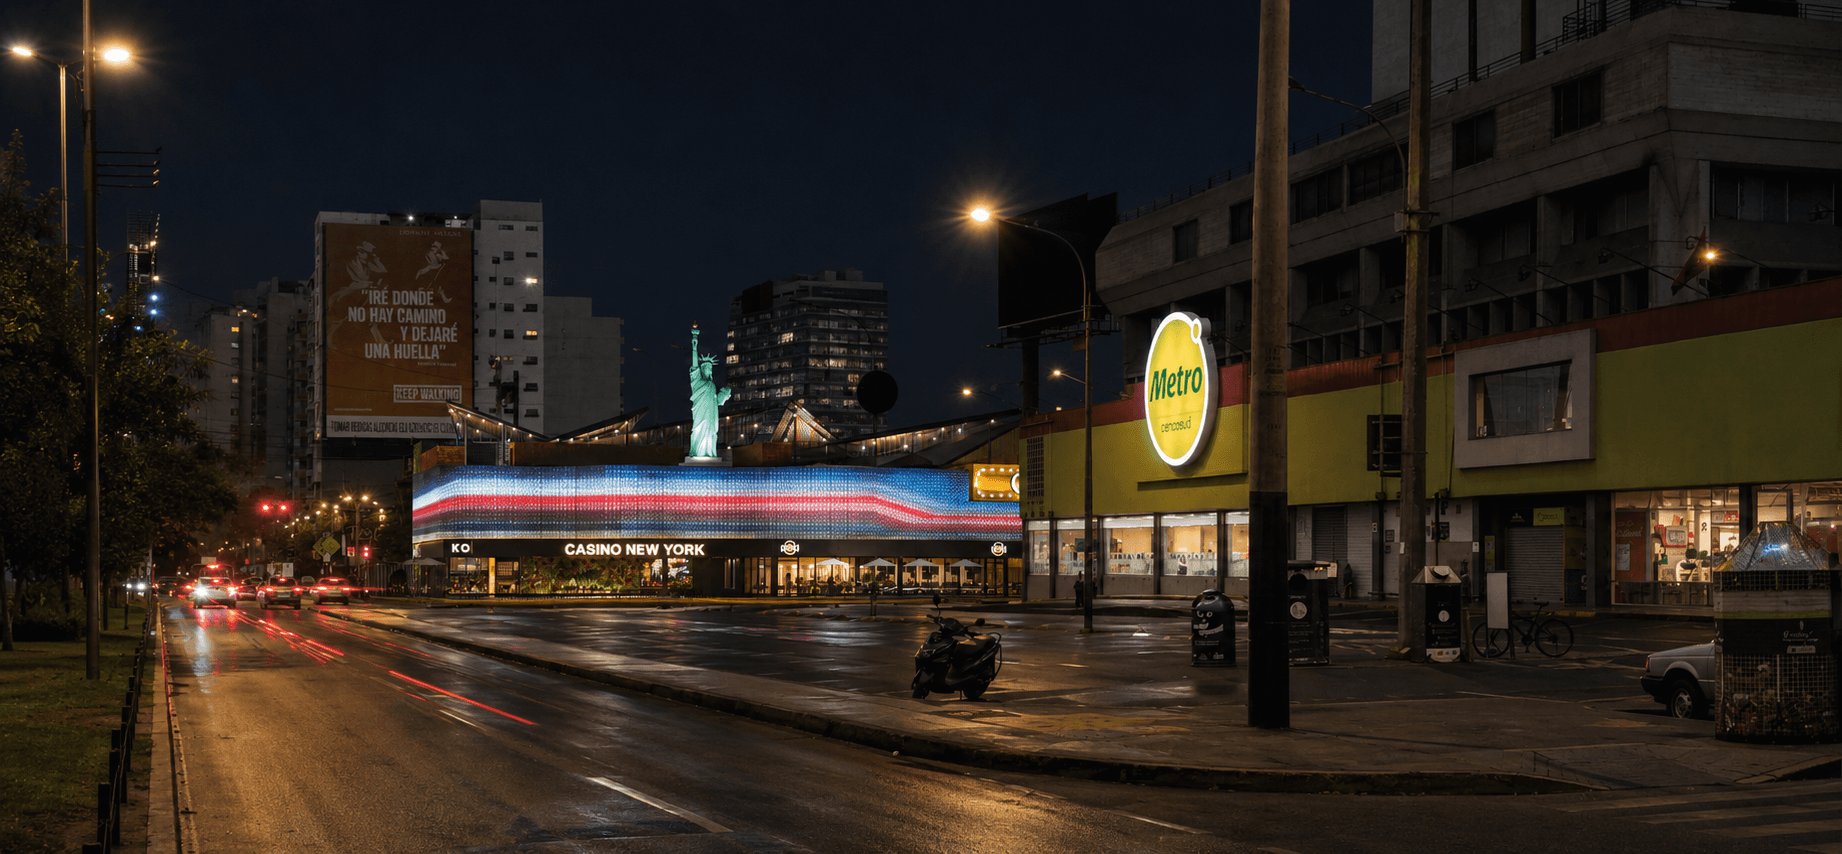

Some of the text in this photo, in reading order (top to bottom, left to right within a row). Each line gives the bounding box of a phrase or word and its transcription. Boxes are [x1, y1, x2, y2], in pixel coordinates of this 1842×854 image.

[392, 290, 434, 306] DONDE
[347, 306, 446, 324] NO HAY CAMINO
[400, 322, 458, 342] Y DEJARÉ
[364, 343, 391, 359] UNA
[1149, 365, 1203, 402] Metro
[396, 387, 459, 400] KEEP WALKING
[451, 543, 471, 554] KO
[564, 543, 706, 557] CASINO NEW YORK
